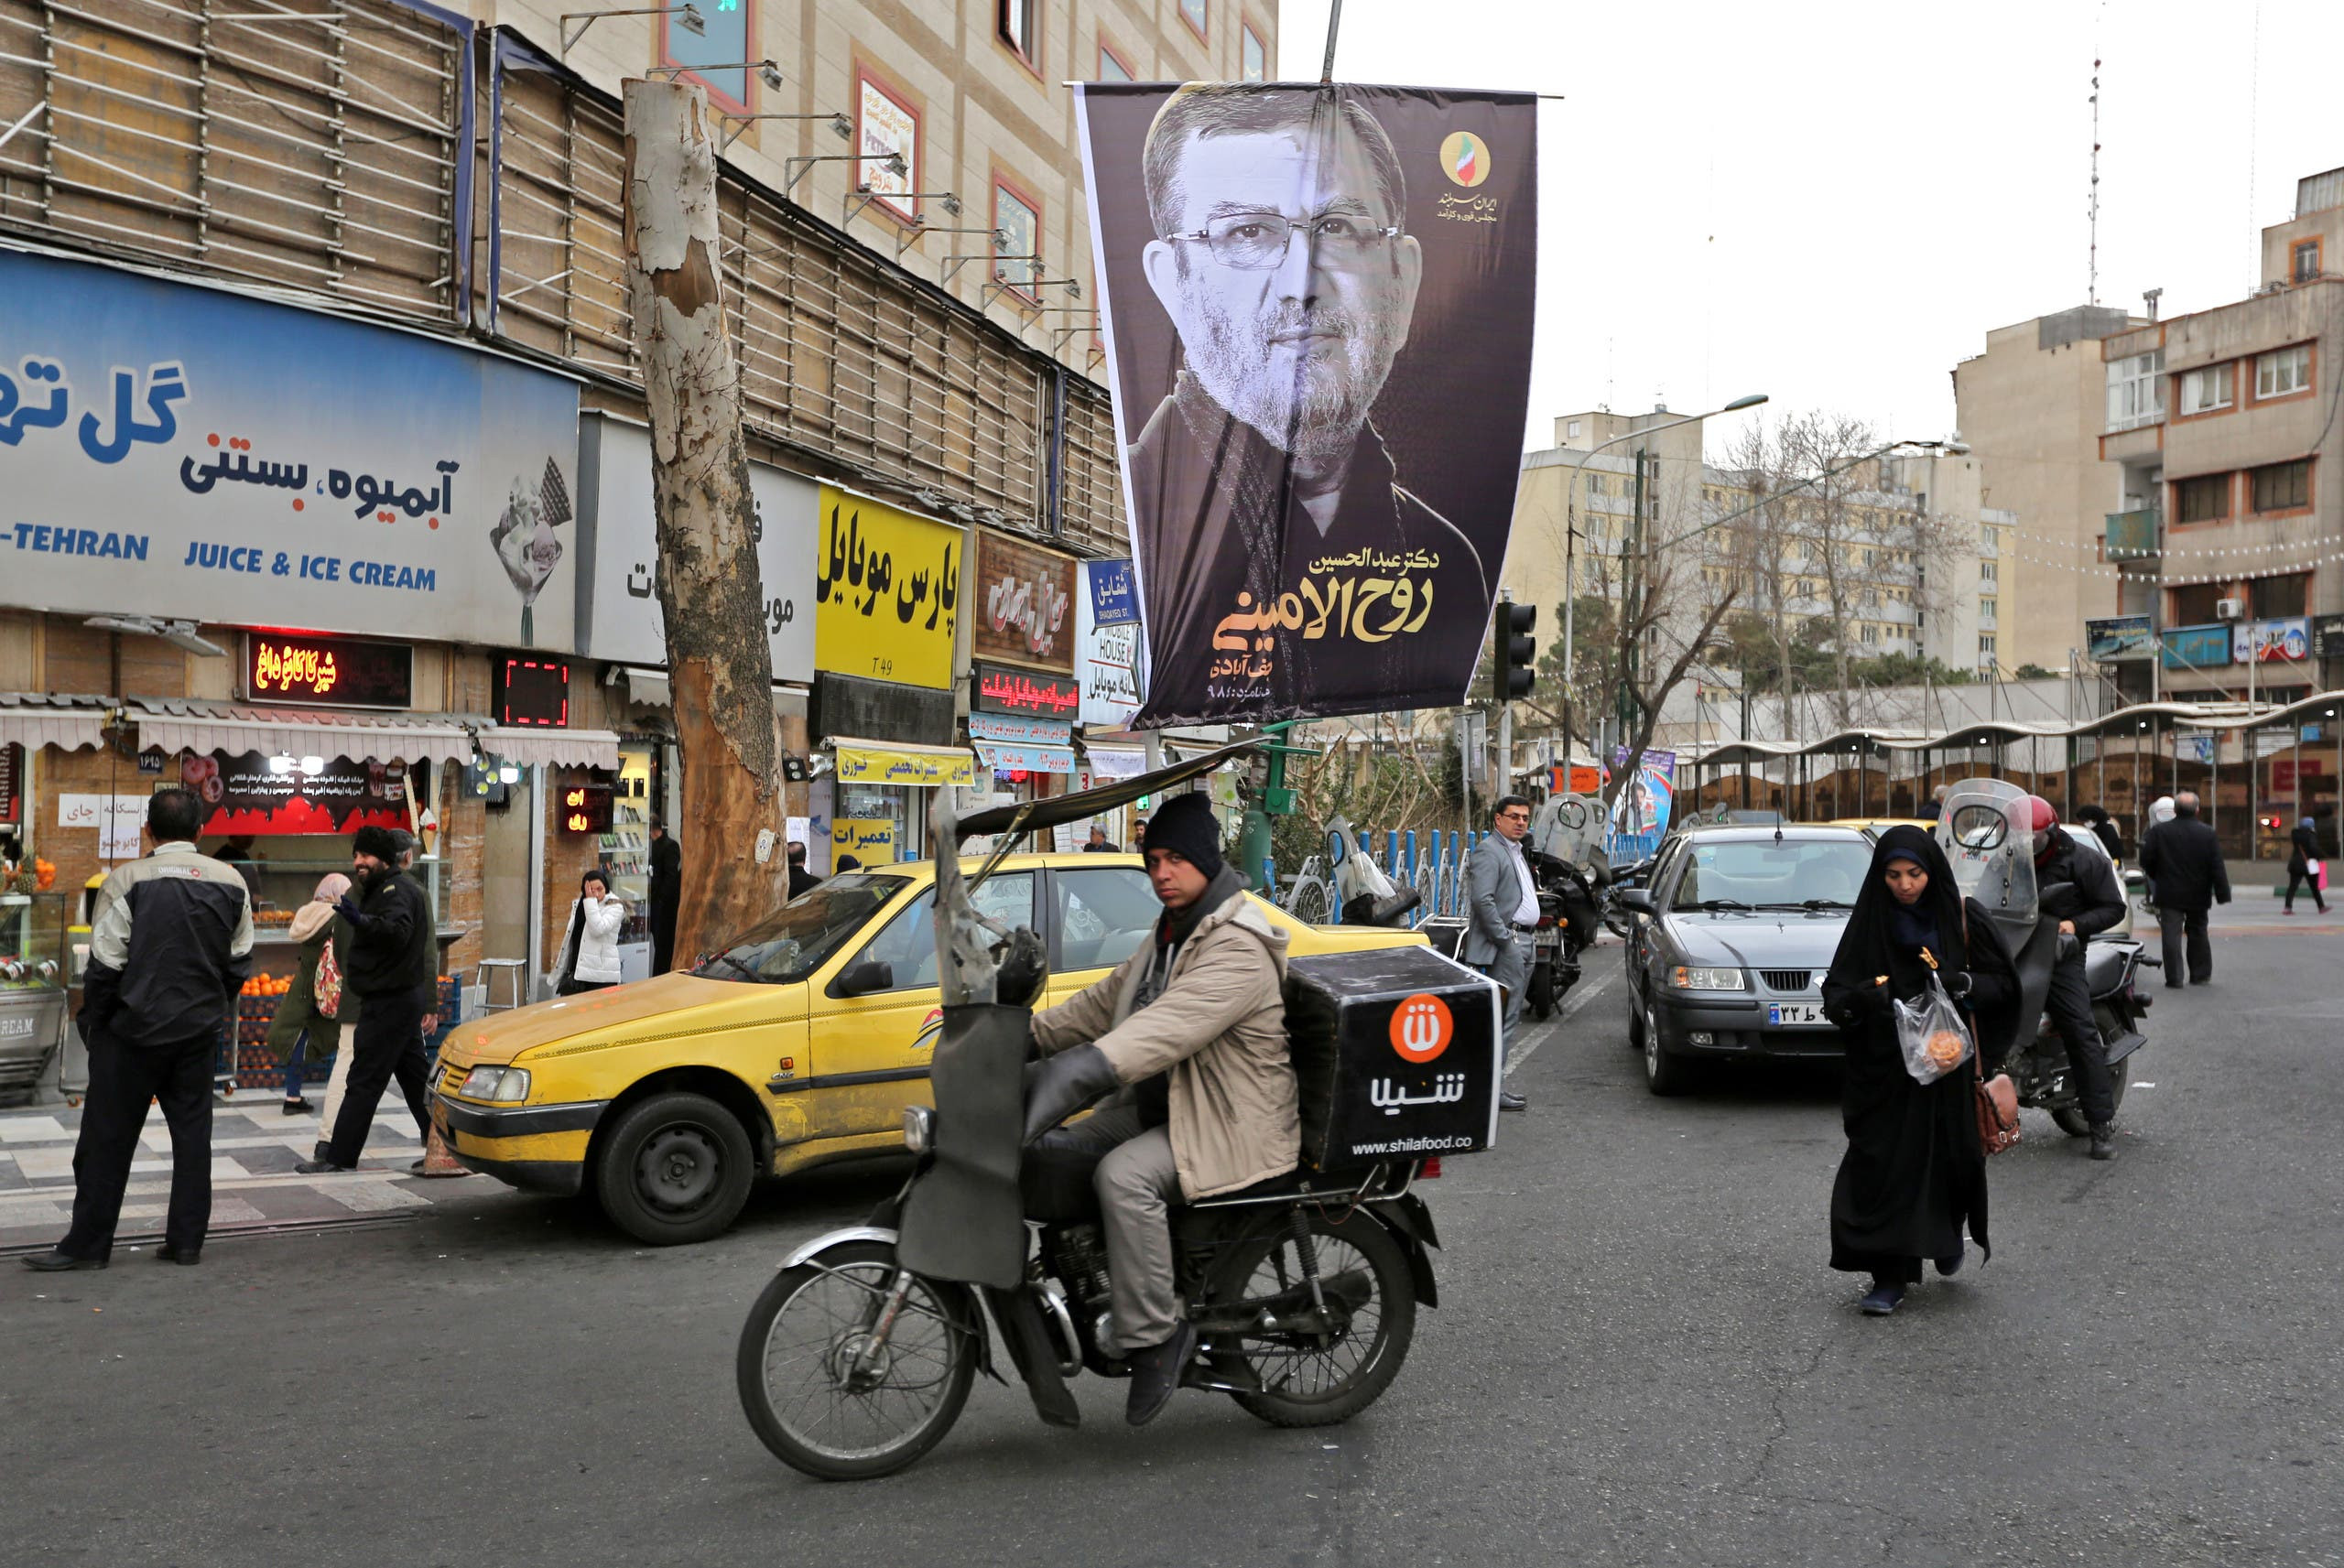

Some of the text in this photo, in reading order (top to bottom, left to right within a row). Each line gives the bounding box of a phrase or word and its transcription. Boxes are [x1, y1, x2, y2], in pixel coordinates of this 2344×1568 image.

[79, 367, 186, 464] گل
[180, 433, 309, 512] بستنی
[184, 541, 437, 593] JUICE & ICE CREAM
[817, 503, 892, 617] موبایل
[1397, 548, 1440, 576] دکتر
[897, 540, 957, 639] پارس
[1098, 573, 1128, 607] شقایق
[881, 658, 893, 676] 49
[1101, 640, 1125, 663] HOUSE
[841, 753, 867, 777] فوری
[67, 804, 93, 822] چای
[834, 826, 892, 850] تعمیرات
[1371, 1073, 1465, 1116] شیلا
[1352, 1135, 1472, 1156] www.shilafood.co
